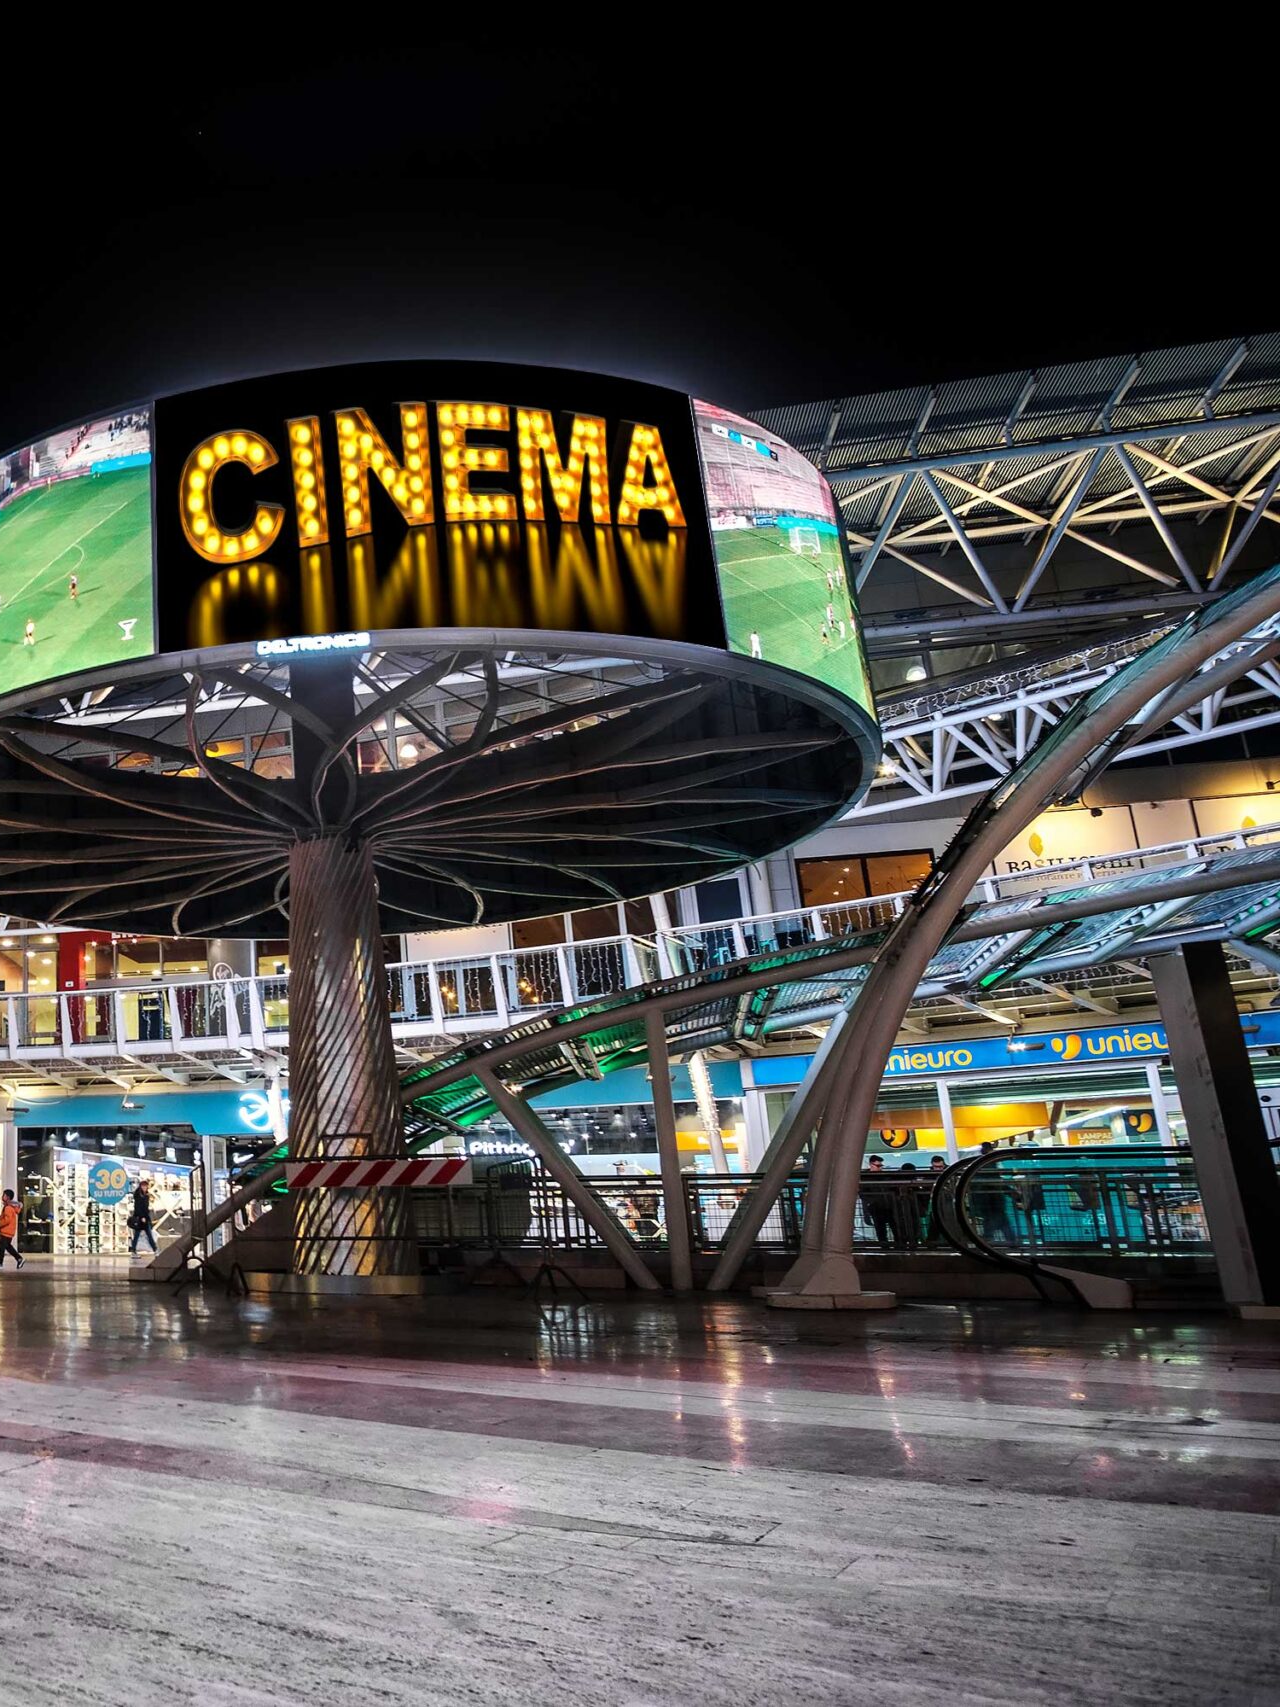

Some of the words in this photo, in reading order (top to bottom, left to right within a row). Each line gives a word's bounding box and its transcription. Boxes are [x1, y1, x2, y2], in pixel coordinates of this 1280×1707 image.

[179, 400, 688, 564] CINEMA
[884, 1046, 973, 1073] nieuro
[104, 1190, 125, 1198] TUTTO
